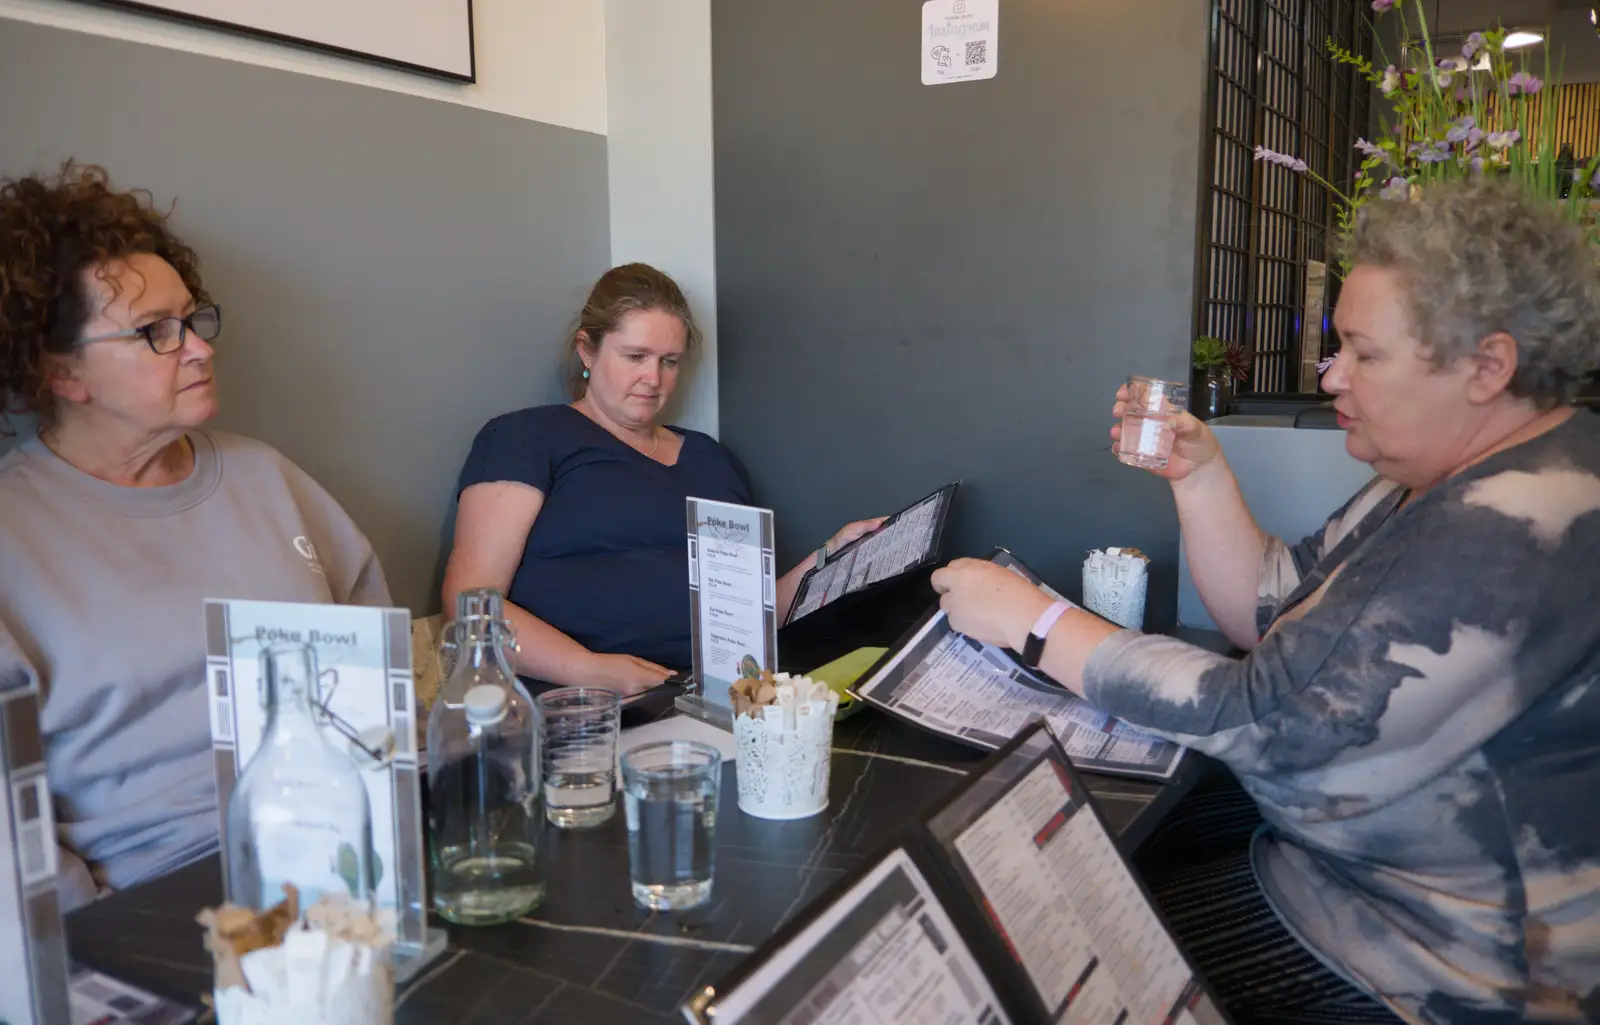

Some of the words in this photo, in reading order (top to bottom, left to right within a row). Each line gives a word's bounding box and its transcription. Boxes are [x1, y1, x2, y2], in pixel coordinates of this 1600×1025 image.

[707, 515, 727, 528] Poke
[728, 519, 749, 532] Bowl
[254, 625, 302, 643] Poke
[308, 628, 357, 645] Bowl
